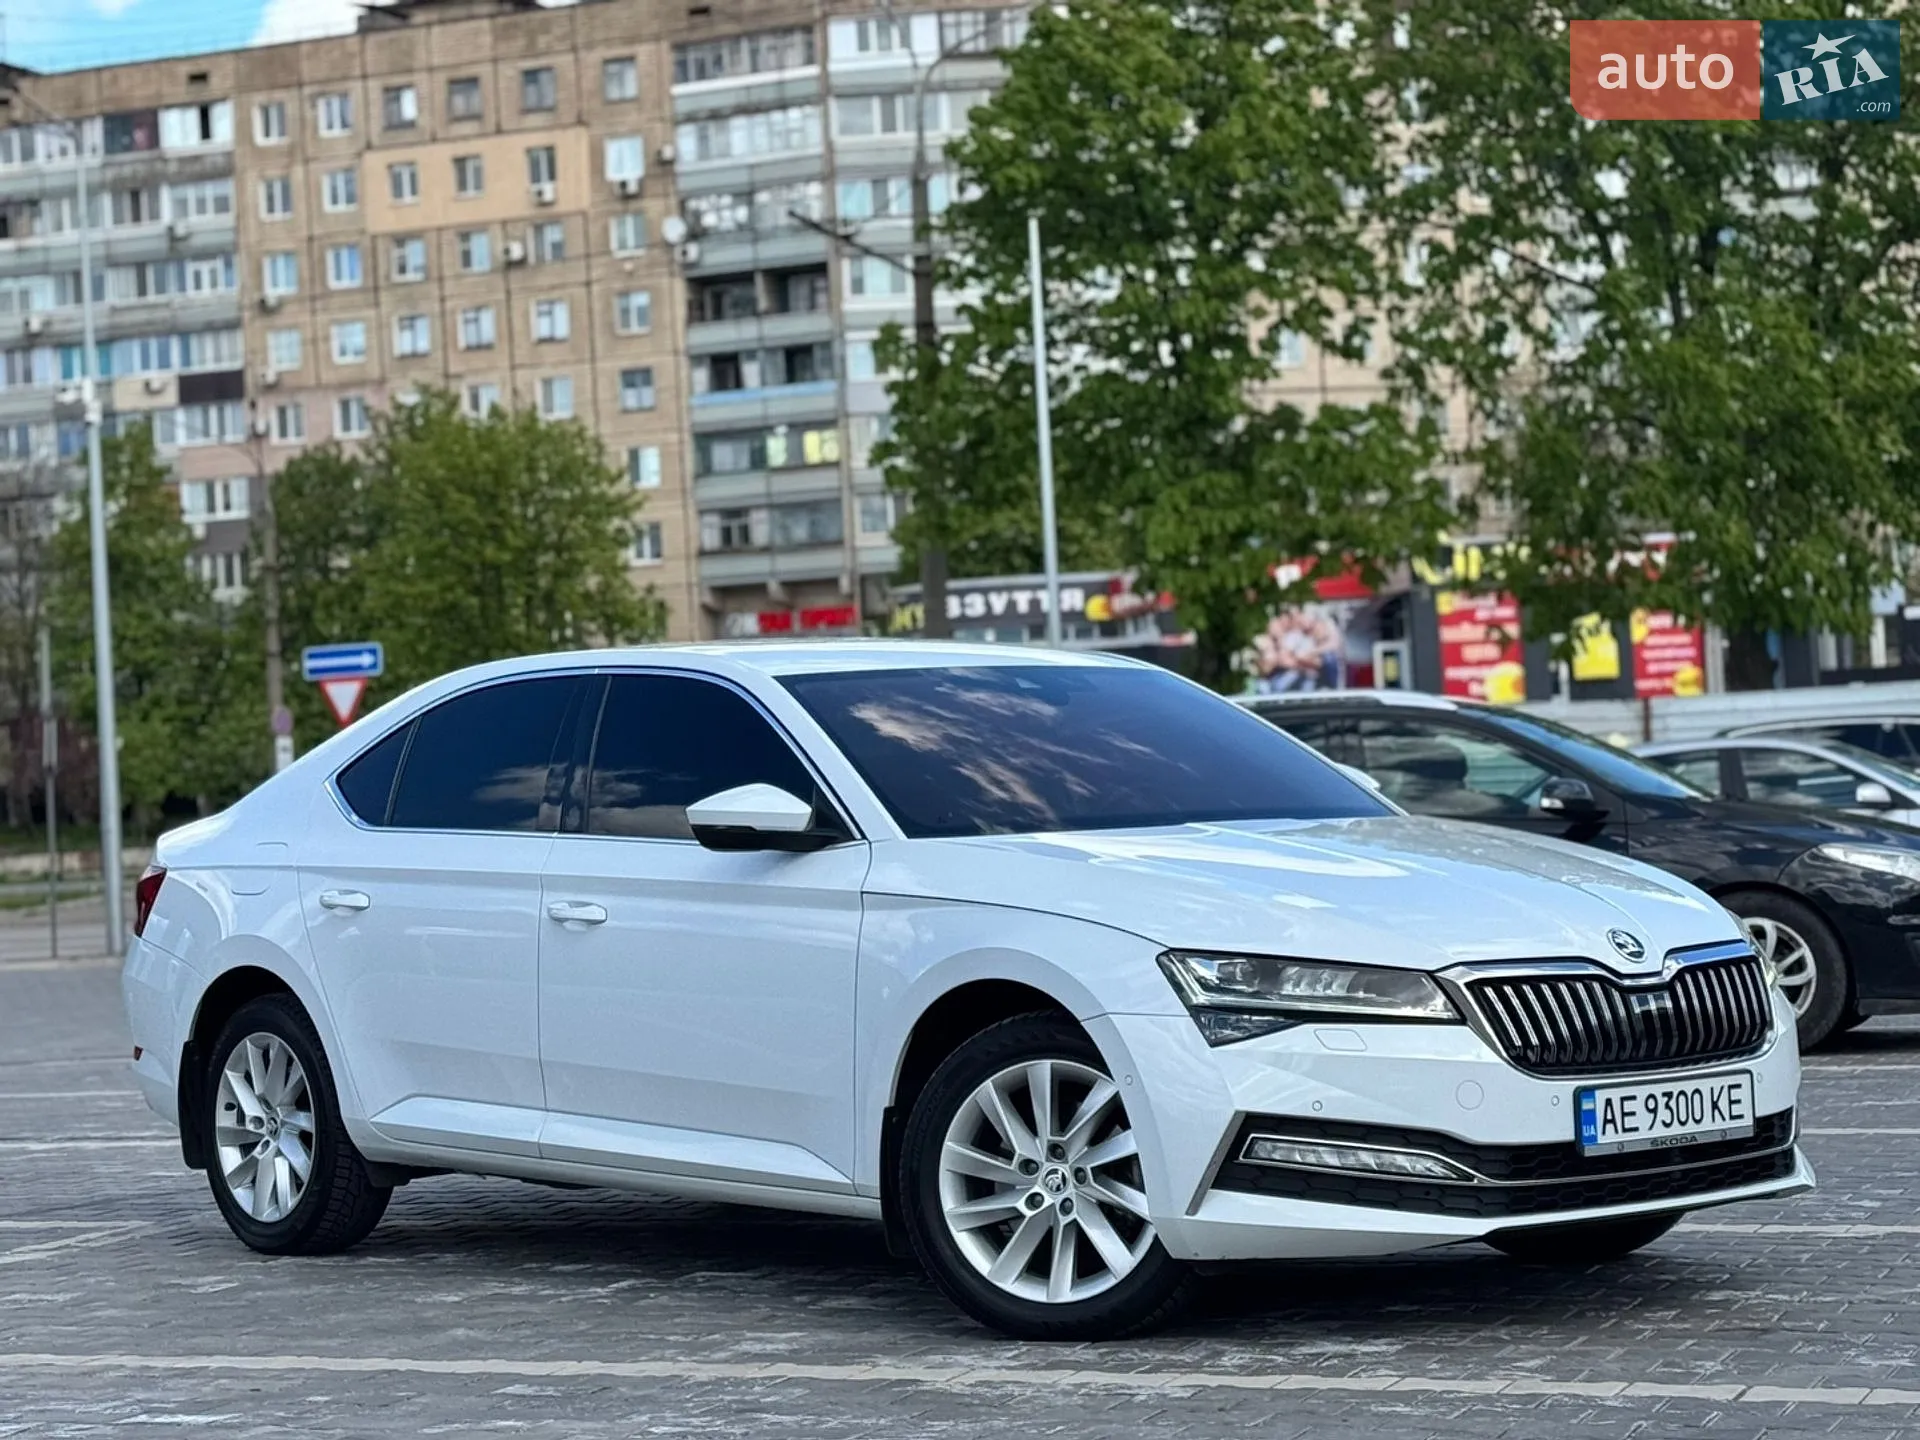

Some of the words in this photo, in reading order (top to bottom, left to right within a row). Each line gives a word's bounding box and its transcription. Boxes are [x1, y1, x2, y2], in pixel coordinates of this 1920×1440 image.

[1602, 1095, 1639, 1136] AE
[1644, 1088, 1704, 1131] 9300
[1711, 1083, 1744, 1123] KE
[1582, 1124, 1596, 1137] UA
